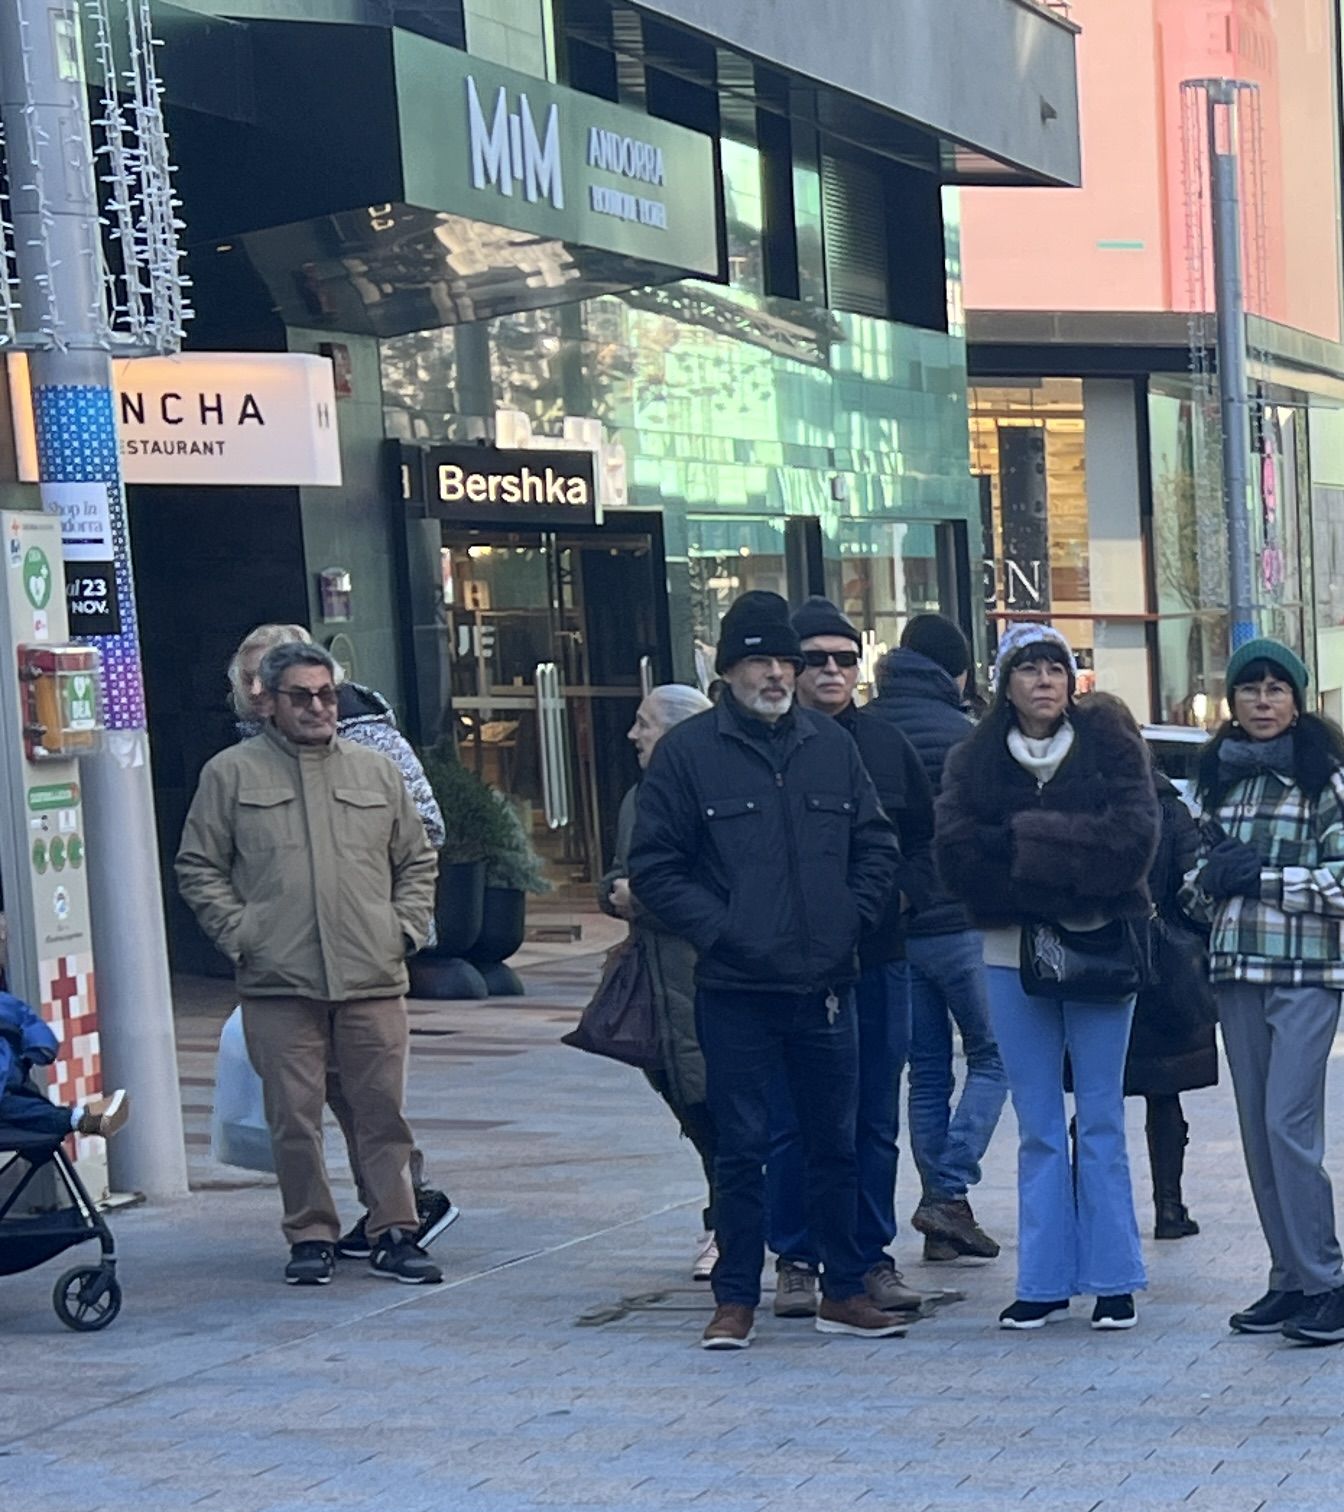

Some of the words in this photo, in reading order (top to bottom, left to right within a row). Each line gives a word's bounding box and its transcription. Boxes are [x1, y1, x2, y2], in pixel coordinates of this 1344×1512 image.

[588, 126, 665, 187] ANDORRA
[120, 392, 266, 427] NCHA
[437, 463, 589, 505] Bershka
[61, 518, 104, 533] dorra
[82, 578, 107, 597] 23
[71, 600, 110, 614] NOV.
